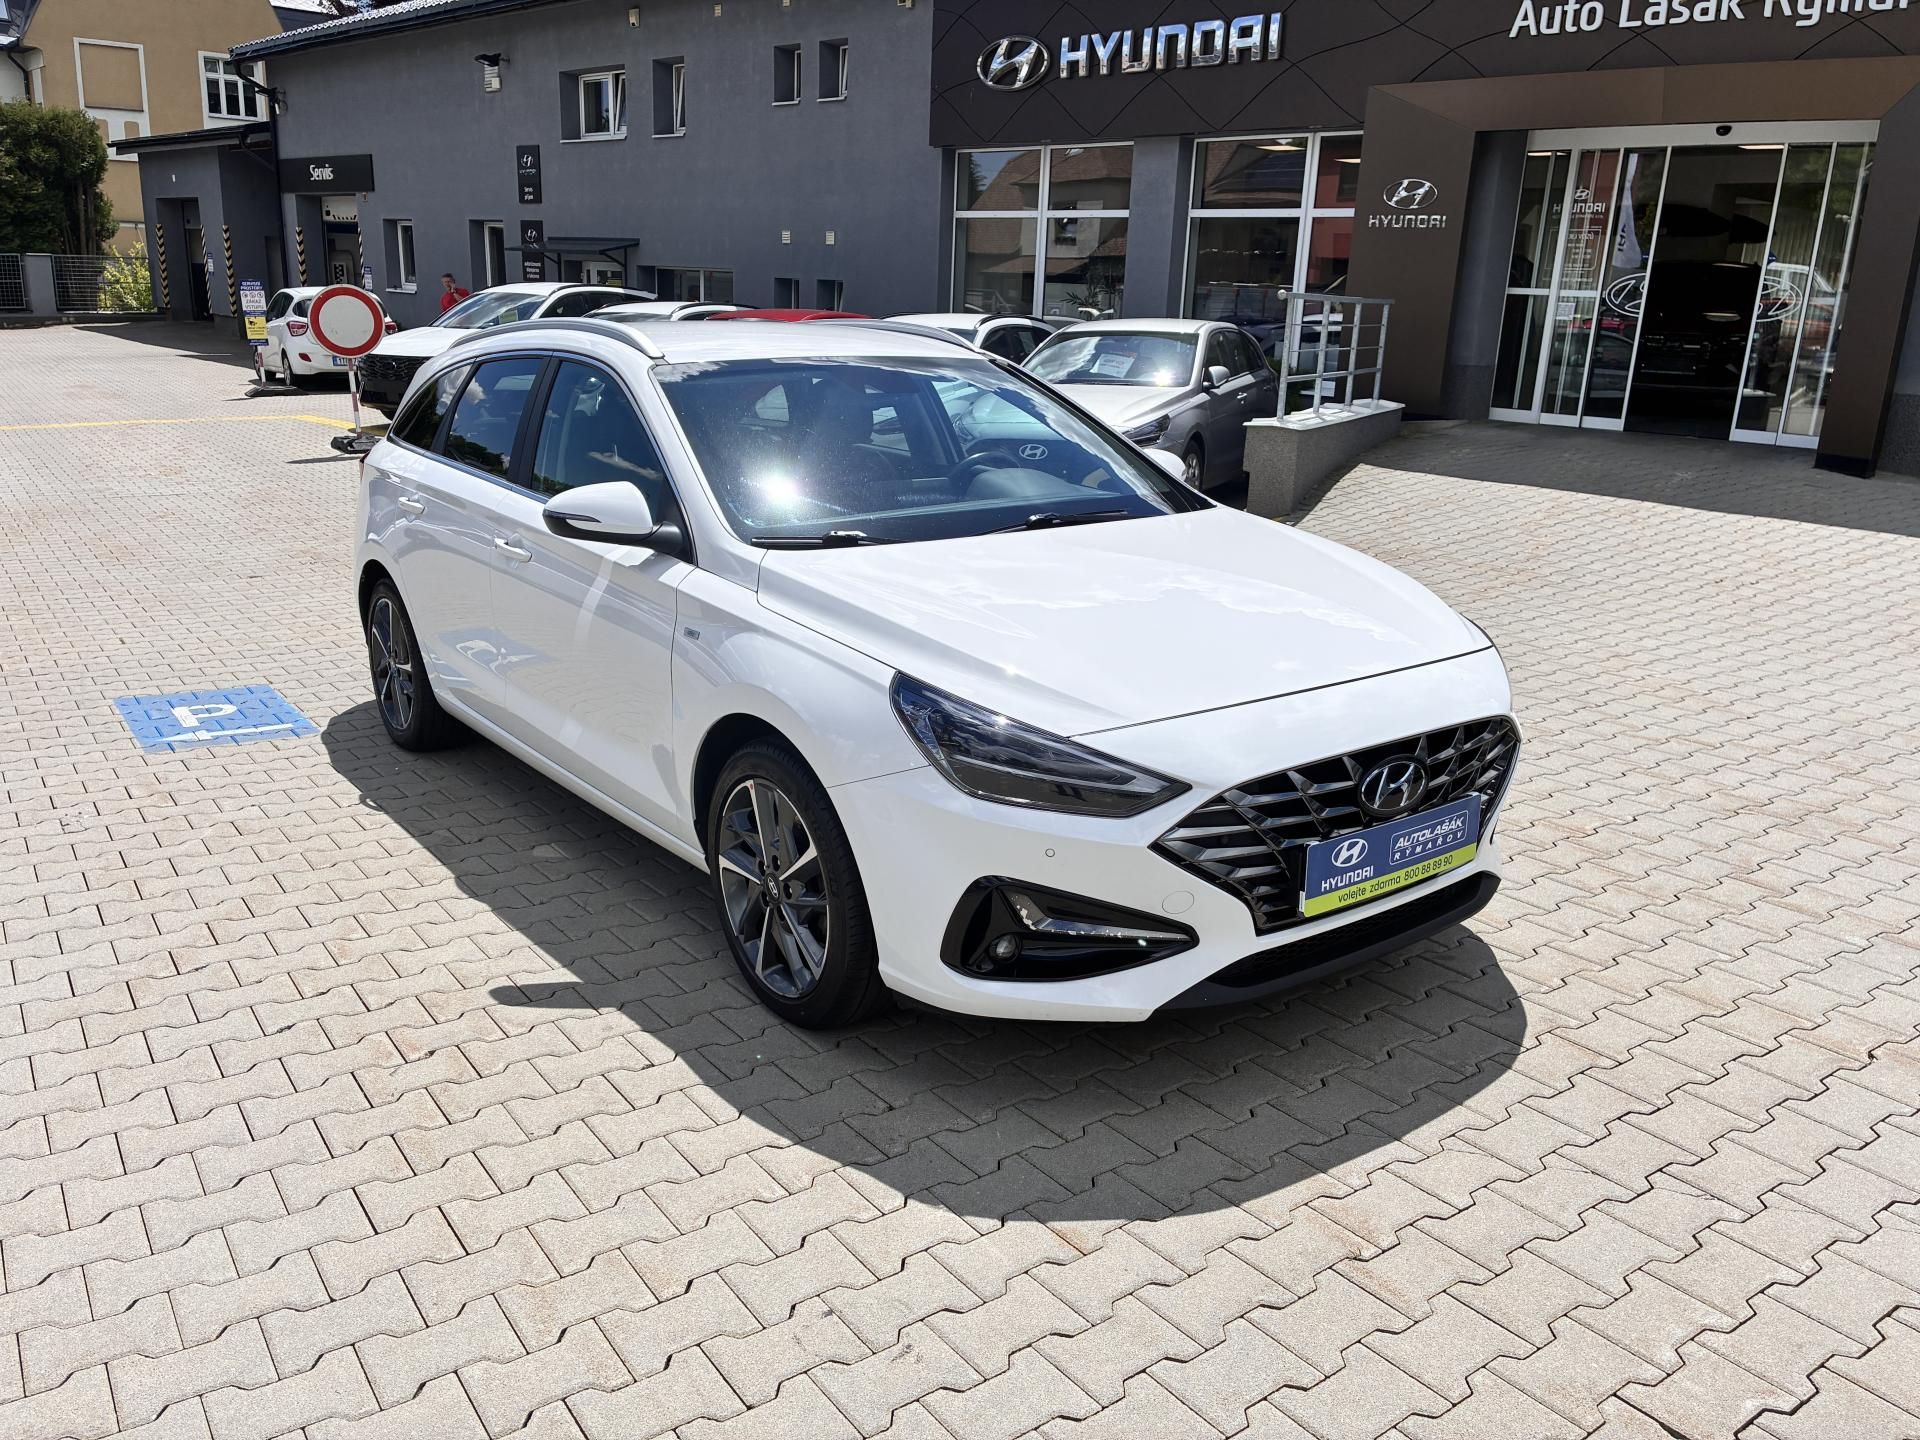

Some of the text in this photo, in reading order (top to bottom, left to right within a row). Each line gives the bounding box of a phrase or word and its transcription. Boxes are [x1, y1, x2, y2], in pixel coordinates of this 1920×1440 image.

[1509, 0, 1604, 37] Auto
[1060, 12, 1283, 78] HYUNDAI
[309, 163, 334, 181] Servis
[1368, 214, 1447, 228] HYUNDAI
[1393, 831, 1464, 861] RÝMAŘOV
[1395, 816, 1465, 850] AUTOLAŠÁK
[1321, 865, 1374, 892] HYUNDAI
[1338, 854, 1453, 904] volejte zdarma 800 88 89 90
